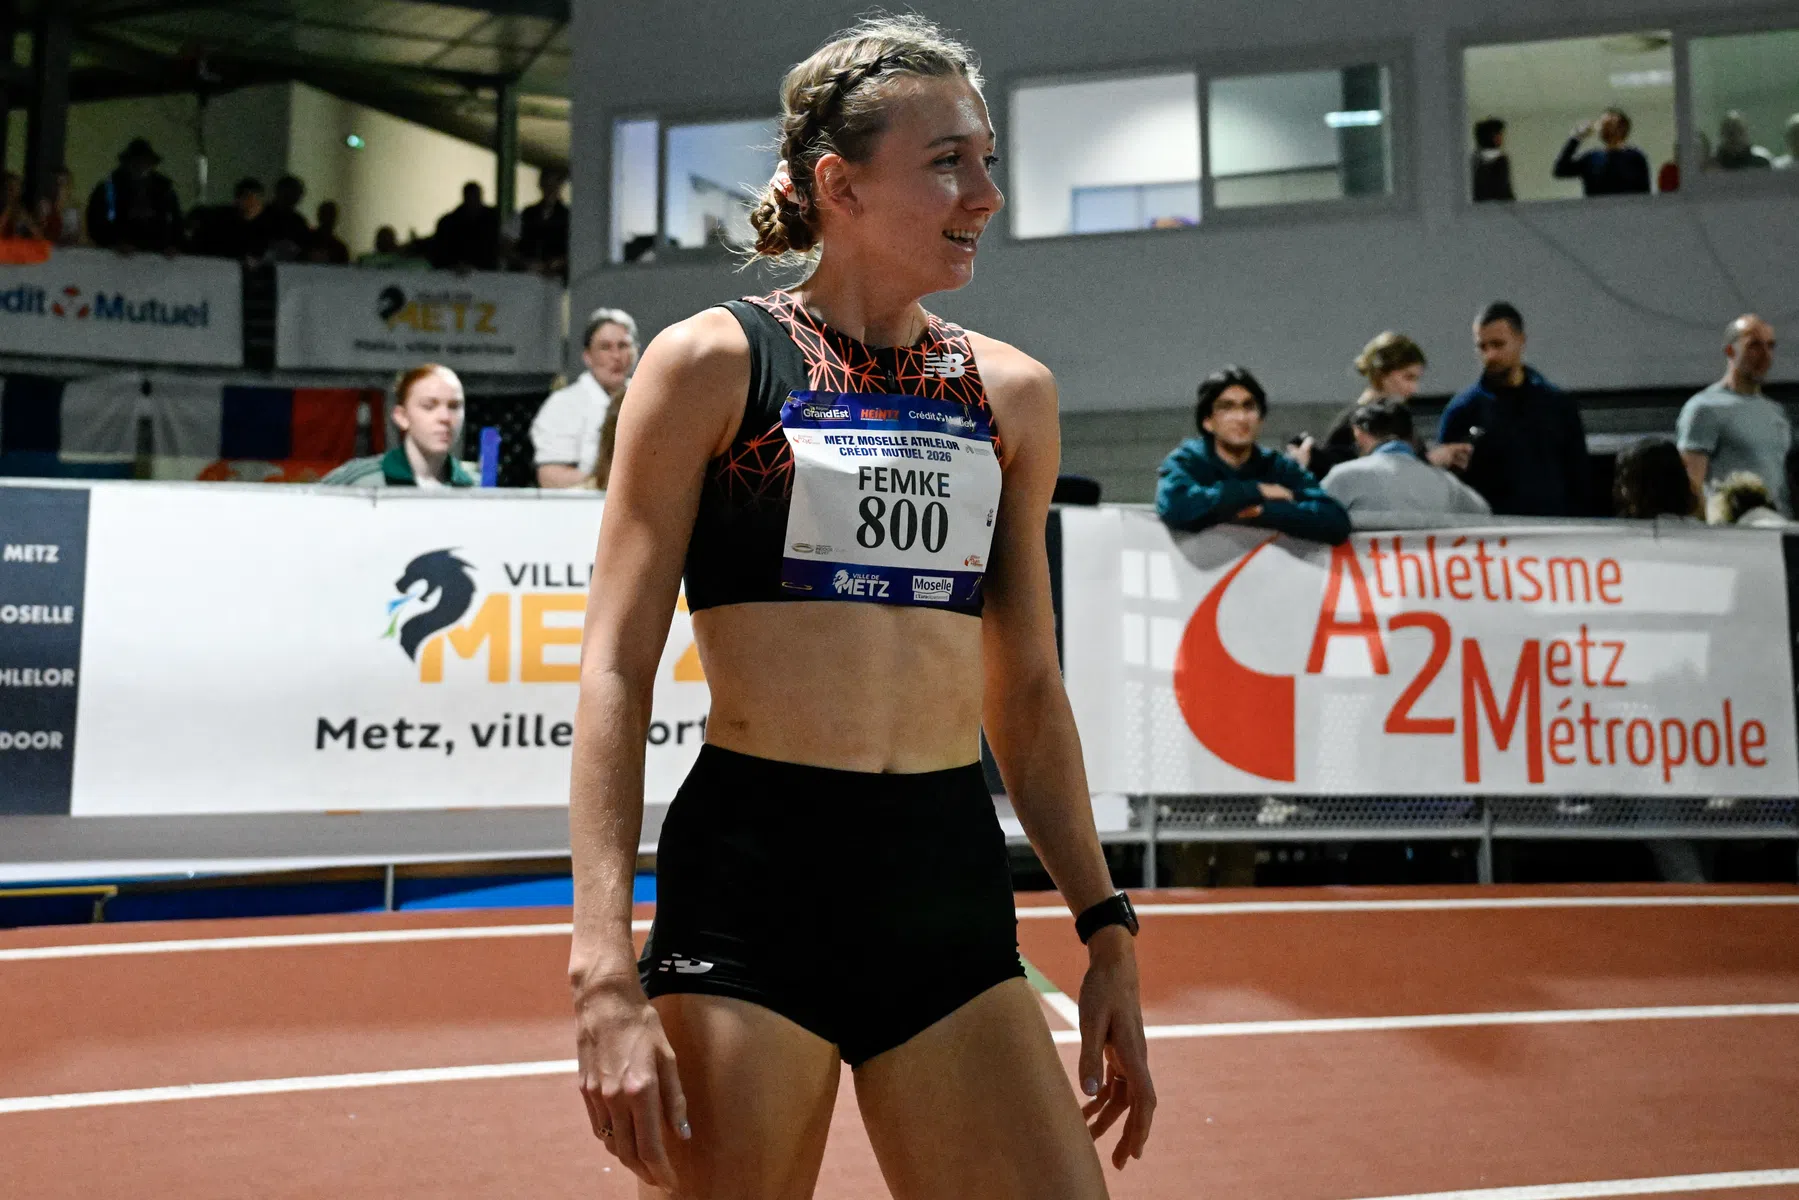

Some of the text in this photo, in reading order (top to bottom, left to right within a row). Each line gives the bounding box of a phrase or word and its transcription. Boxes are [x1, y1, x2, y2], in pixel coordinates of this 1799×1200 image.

[94, 290, 209, 328] Mutuel
[908, 410, 937, 421] Crédit
[824, 435, 855, 446] METZ
[857, 435, 909, 447] MOSELLE
[911, 436, 960, 451] ATHLELOR
[840, 446, 952, 462] CRÉDIT MUTUEL 2026
[858, 465, 950, 498] FEMKE
[856, 495, 948, 553] 800
[3, 544, 60, 564] METZ
[503, 563, 594, 588] VILL
[853, 572, 870, 580] VILLE
[914, 578, 952, 591] Moselle
[837, 578, 890, 598] METZ
[0, 604, 74, 624] OSELLE
[315, 712, 574, 757] Metz, ville
